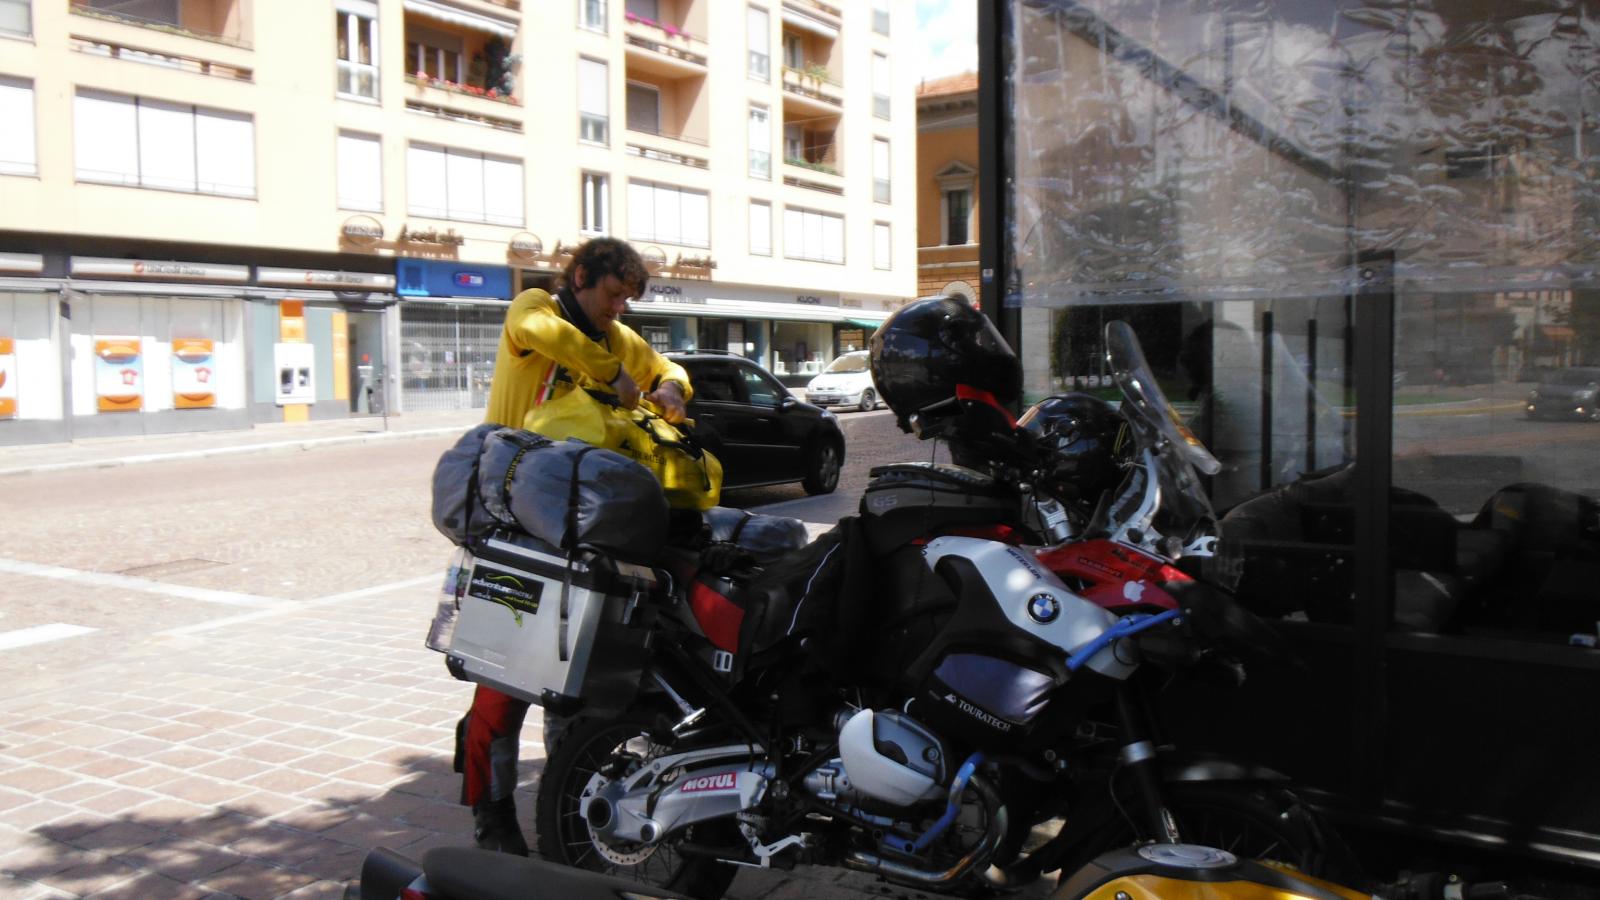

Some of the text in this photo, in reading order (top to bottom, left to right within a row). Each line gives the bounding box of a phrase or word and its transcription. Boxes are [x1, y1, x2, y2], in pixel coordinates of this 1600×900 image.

[649, 284, 683, 295] KUONI
[796, 295, 821, 305] KUONI
[872, 494, 898, 507] GS
[958, 699, 1011, 732] TOURATECH
[682, 773, 735, 791] MOTUL
